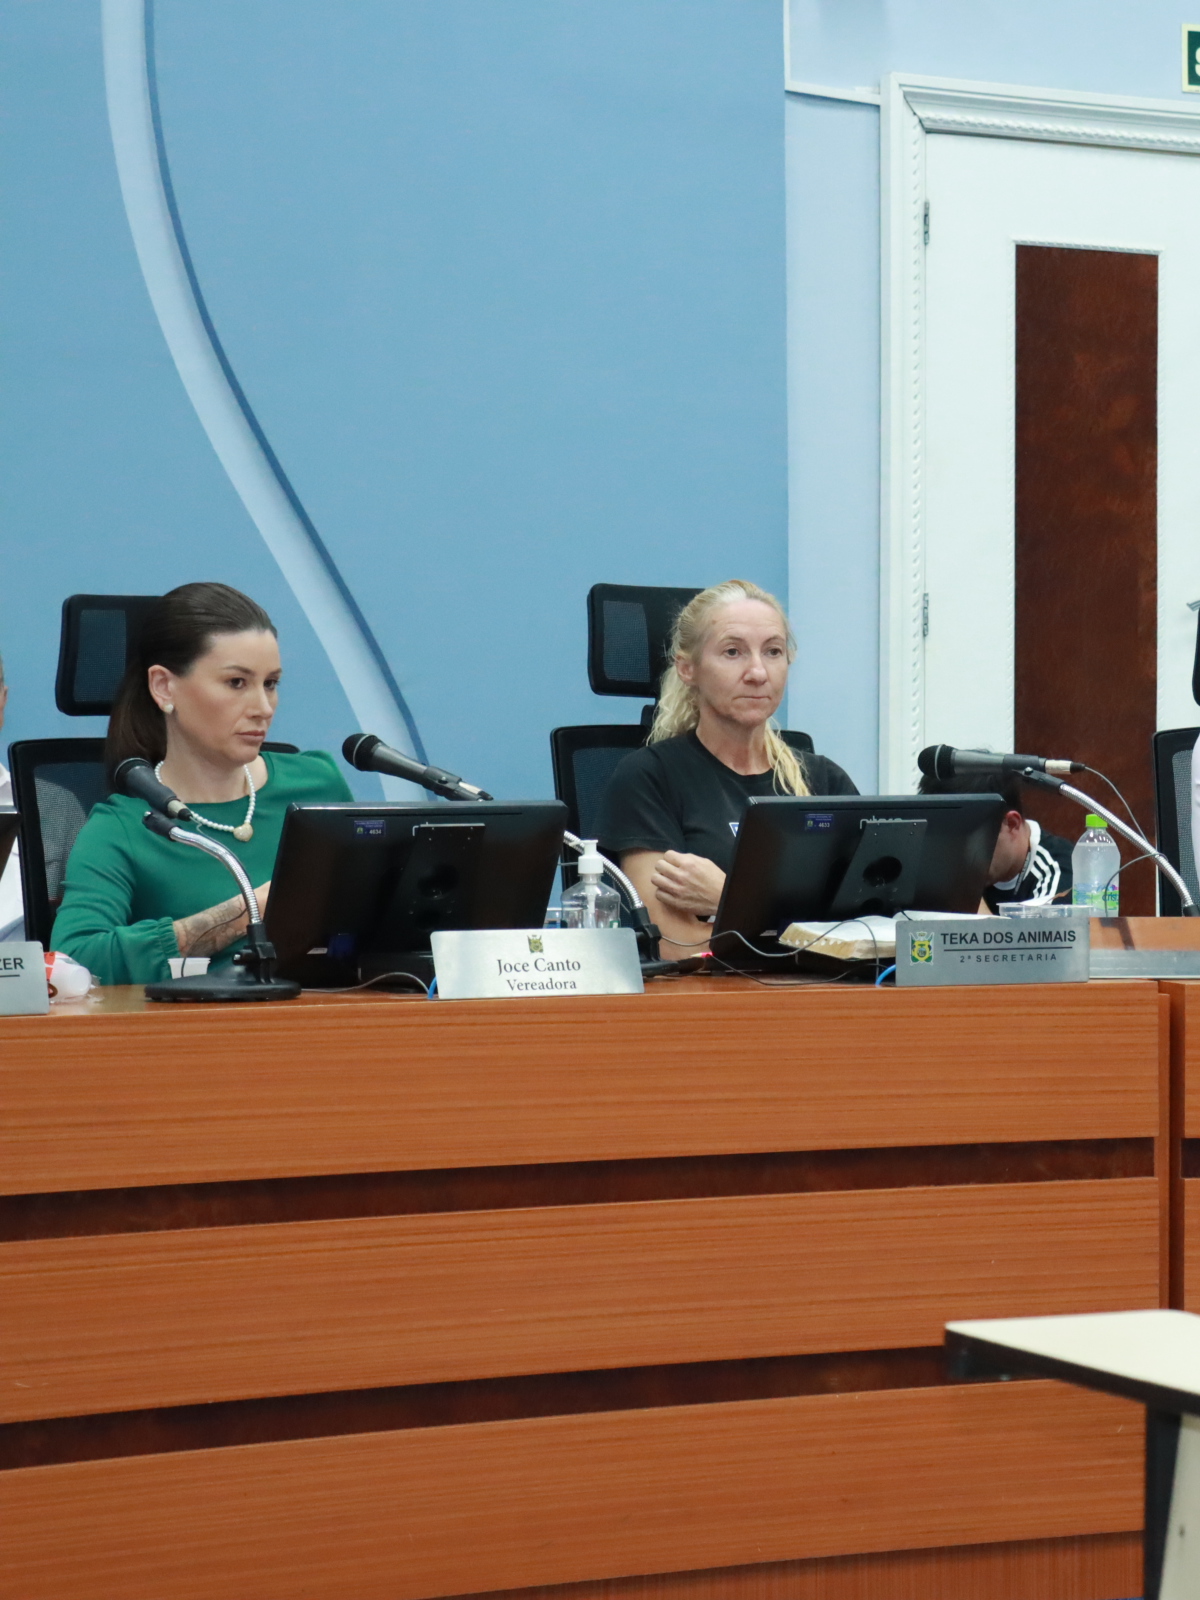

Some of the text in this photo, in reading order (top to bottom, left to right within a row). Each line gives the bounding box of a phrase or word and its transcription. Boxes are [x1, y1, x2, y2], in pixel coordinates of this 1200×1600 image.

[941, 930, 1076, 945] TEKA DOS ANIMAIS
[0, 957, 24, 970] ER
[976, 953, 1057, 963] SECRETARIA
[497, 957, 581, 976] Joce Canto
[506, 977, 577, 991] Vereadora
